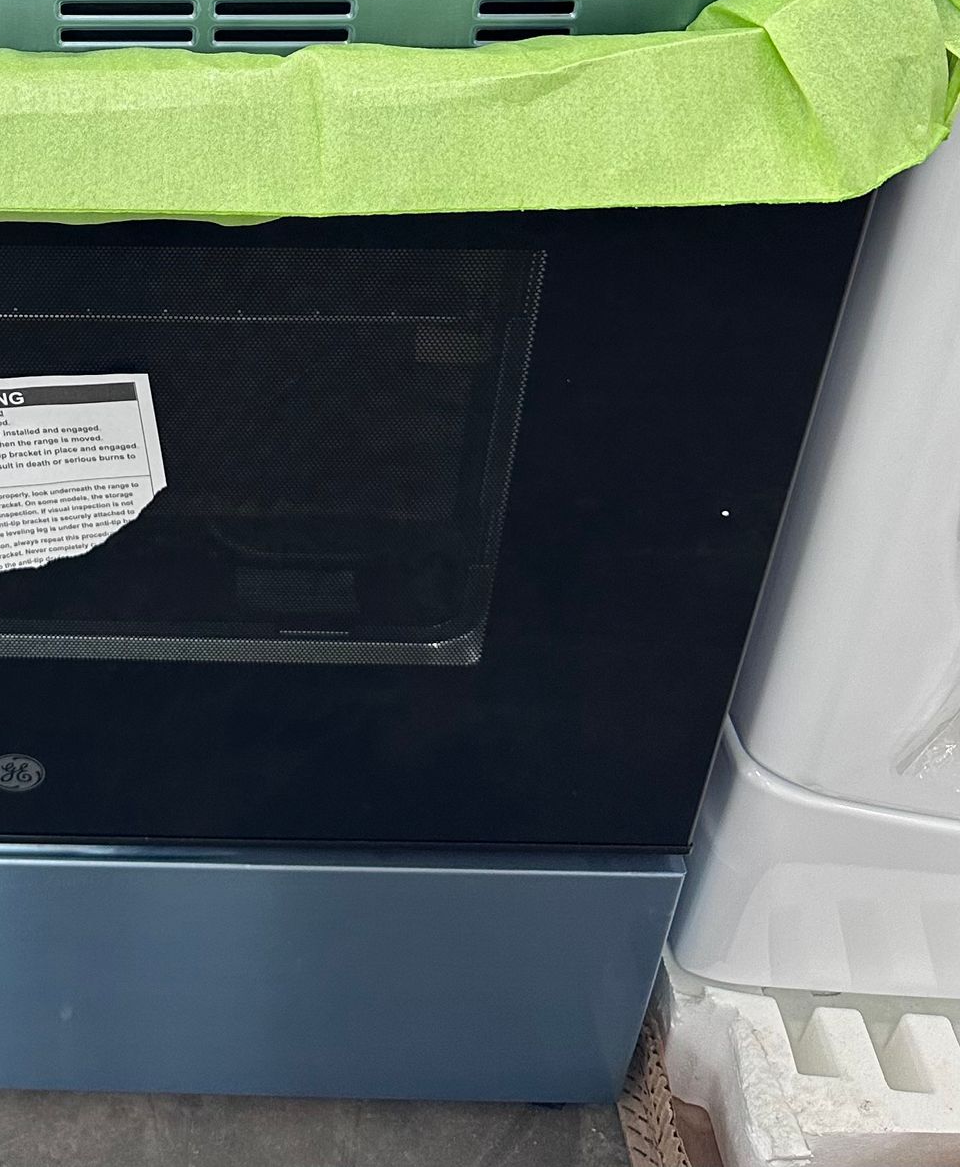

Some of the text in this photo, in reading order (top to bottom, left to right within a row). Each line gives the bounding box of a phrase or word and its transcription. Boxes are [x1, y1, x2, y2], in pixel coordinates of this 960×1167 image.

[3, 428, 40, 438] installed
[18, 438, 31, 446] the
[34, 438, 59, 446] range
[9, 449, 42, 459] bracket
[55, 446, 78, 456] place
[80, 444, 97, 452] and
[16, 461, 24, 469] in
[26, 459, 51, 468] death
[64, 455, 97, 464] serious
[99, 453, 125, 462] burns
[32, 489, 49, 497] look
[50, 485, 92, 496] underneath
[108, 483, 129, 491] range
[105, 491, 134, 500] storage
[48, 505, 70, 514] visual
[72, 502, 111, 512] inspection
[22, 516, 50, 526] bracket
[60, 512, 92, 522] securely
[94, 509, 126, 519] attached
[36, 526, 48, 535] leg
[58, 523, 80, 532] under
[95, 518, 121, 528] anti-tip
[13, 539, 39, 547] always
[40, 536, 64, 545] repeat
[25, 547, 47, 555] Never
[48, 543, 89, 553] completely
[5, 561, 17, 569] the
[18, 557, 44, 567] anti-tip
